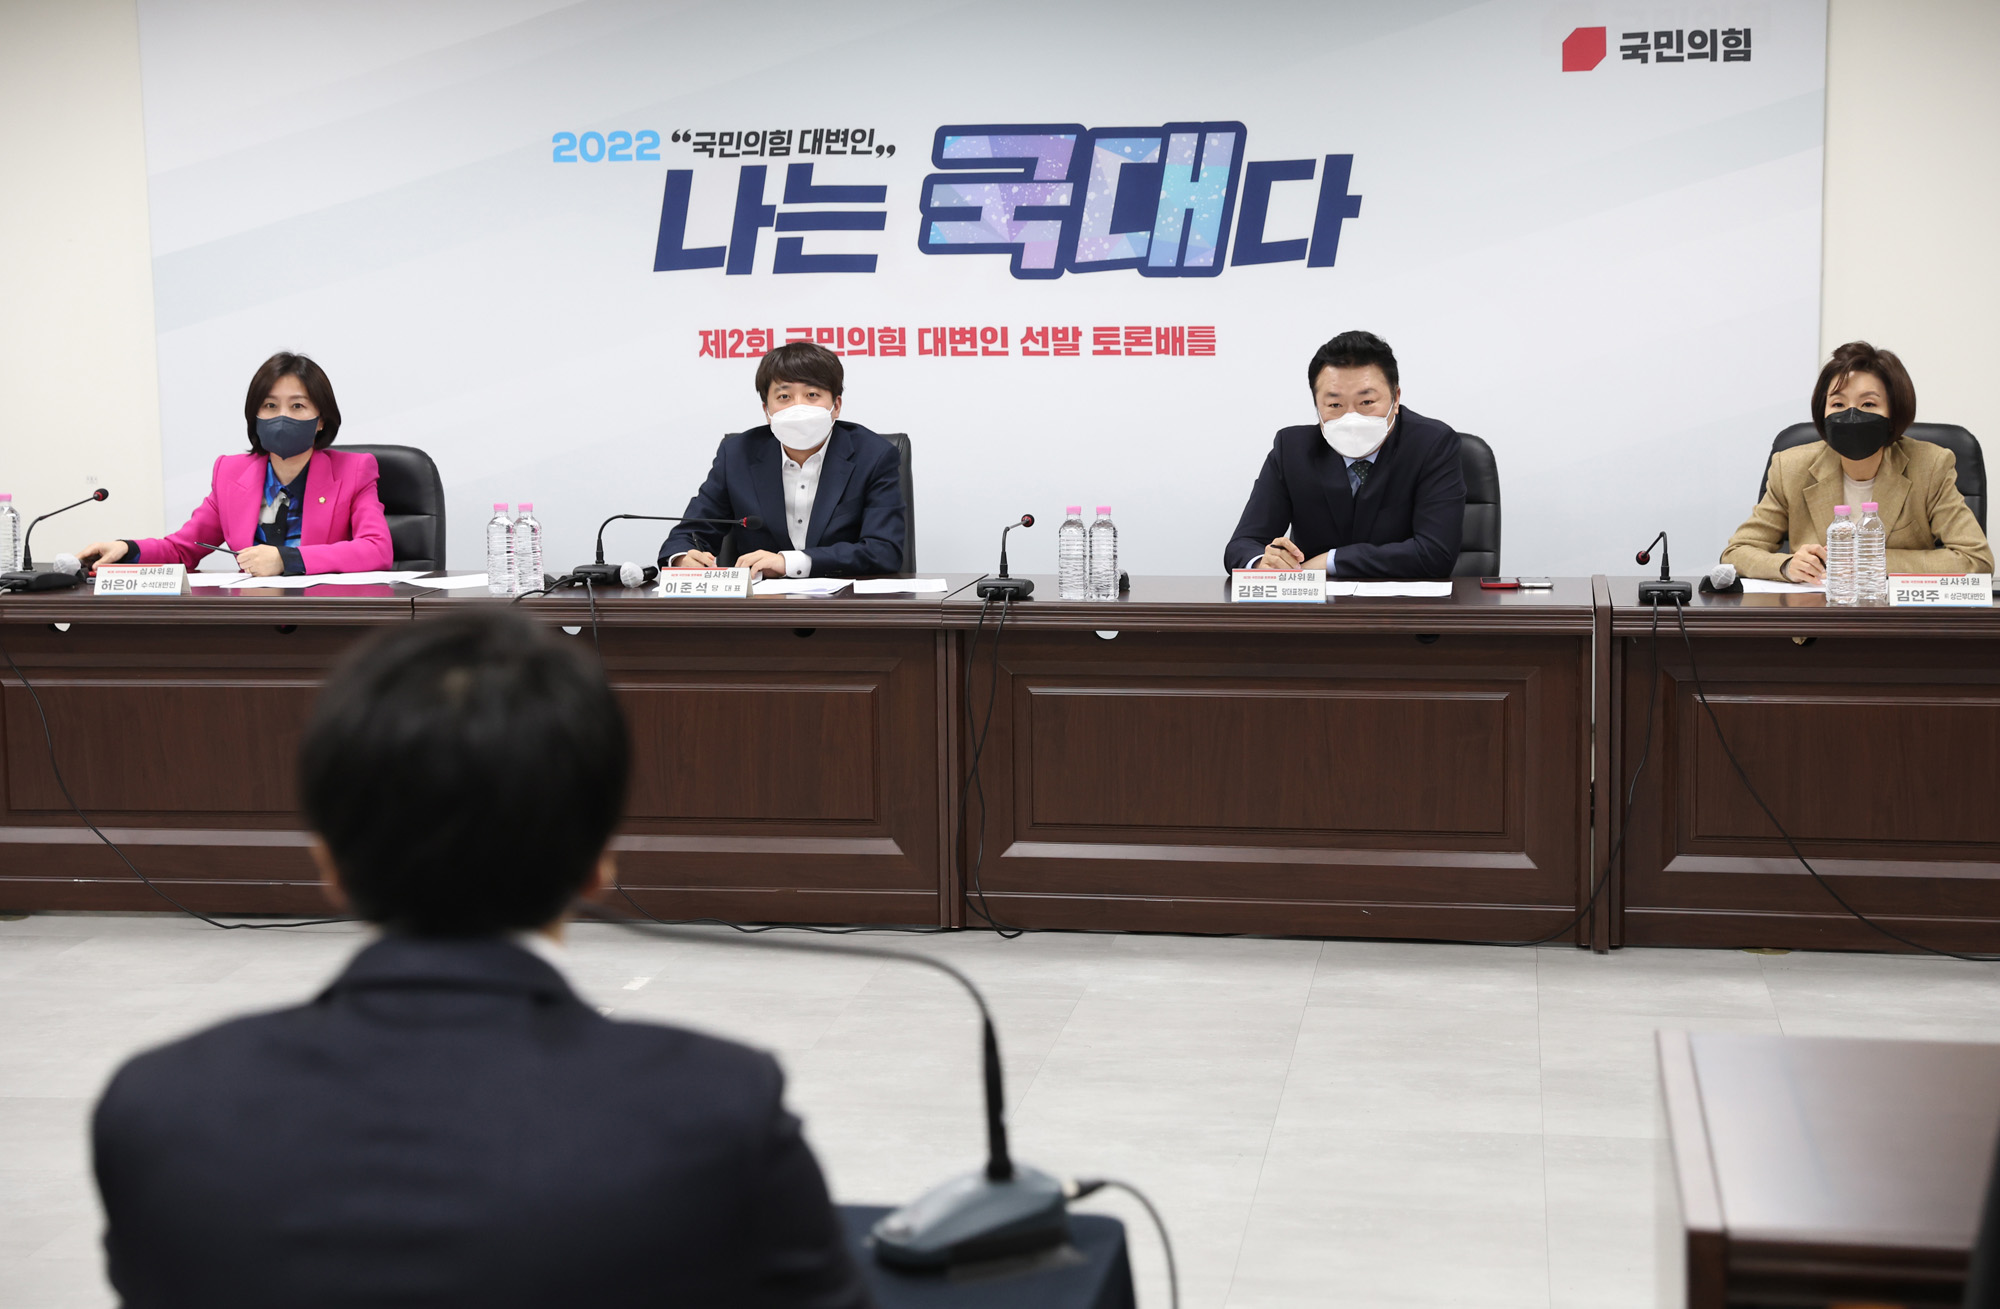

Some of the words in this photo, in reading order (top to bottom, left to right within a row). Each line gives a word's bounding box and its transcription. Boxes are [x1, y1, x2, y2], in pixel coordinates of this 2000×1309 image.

[1619, 27, 1752, 65] 국민의힘
[551, 129, 661, 163] 2022
[653, 162, 888, 276] 나는
[918, 120, 1363, 281] 국대다
[698, 327, 774, 359] 제2회
[917, 326, 1010, 357] 대변인
[1020, 326, 1083, 357] 선발
[1092, 325, 1217, 357] 토론배틀
[139, 567, 174, 576] 심사위원
[704, 570, 740, 579] 심사위원
[1278, 572, 1316, 581] 심사위원
[101, 579, 138, 591] 허은아
[1939, 577, 1981, 586] 심사위원
[665, 582, 708, 594] 이준석
[1238, 585, 1278, 598] 김철근
[1896, 589, 1940, 603] 김연주
